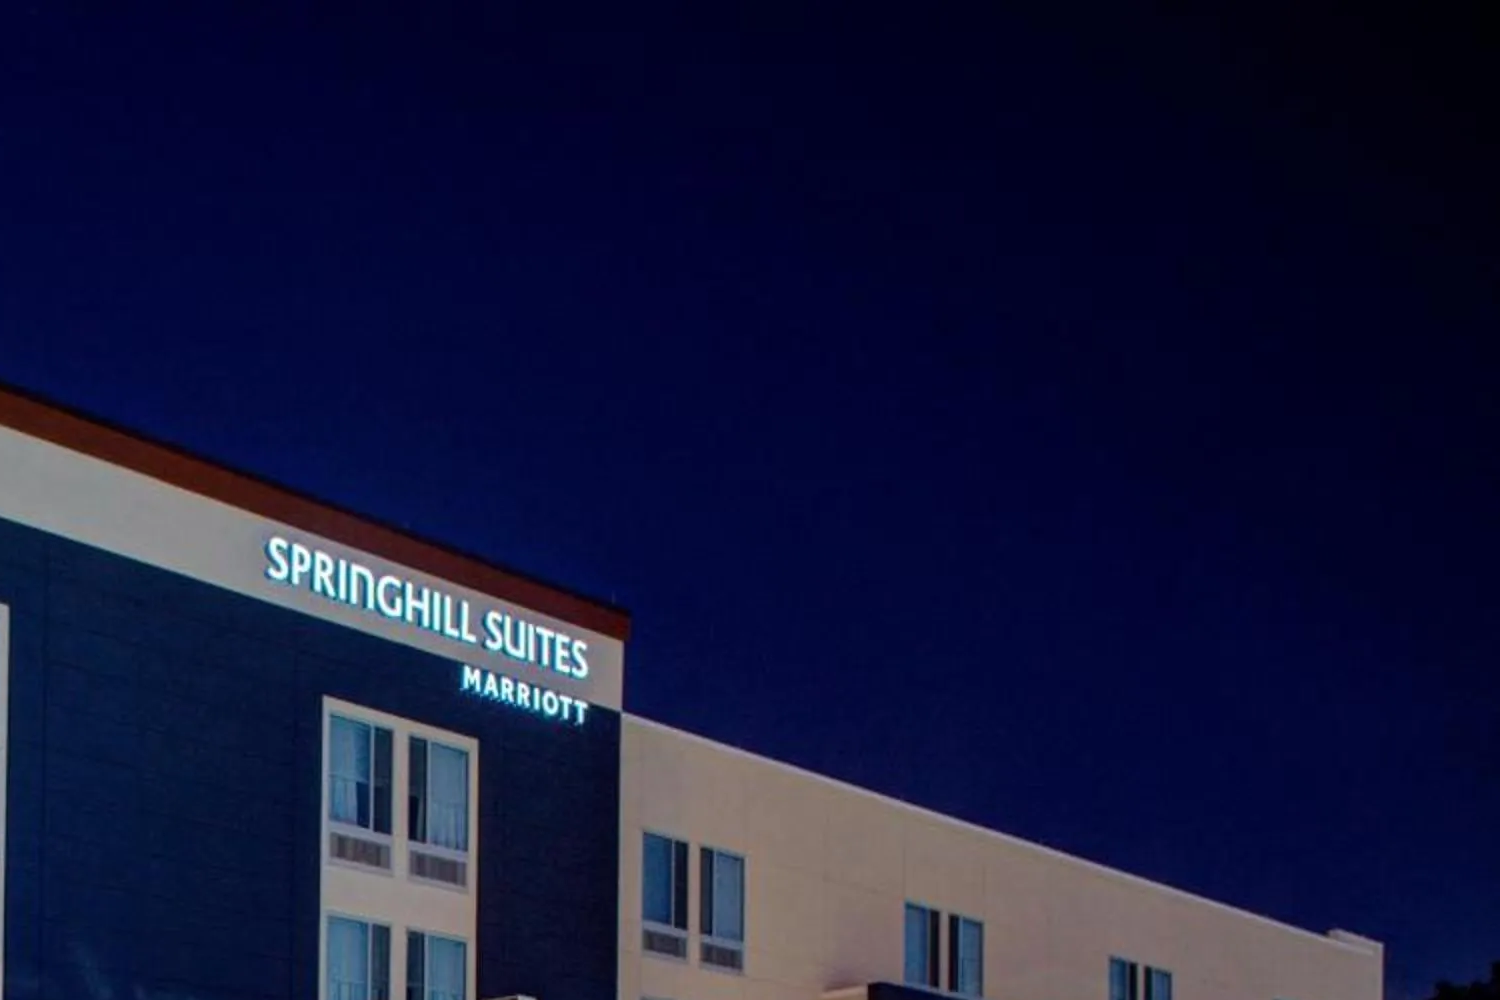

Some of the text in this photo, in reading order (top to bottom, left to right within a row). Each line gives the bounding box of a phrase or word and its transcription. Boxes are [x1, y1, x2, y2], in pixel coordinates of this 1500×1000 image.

[266, 537, 589, 679] SPRINGHILL SUITES
[461, 665, 589, 726] MARRIOTT
